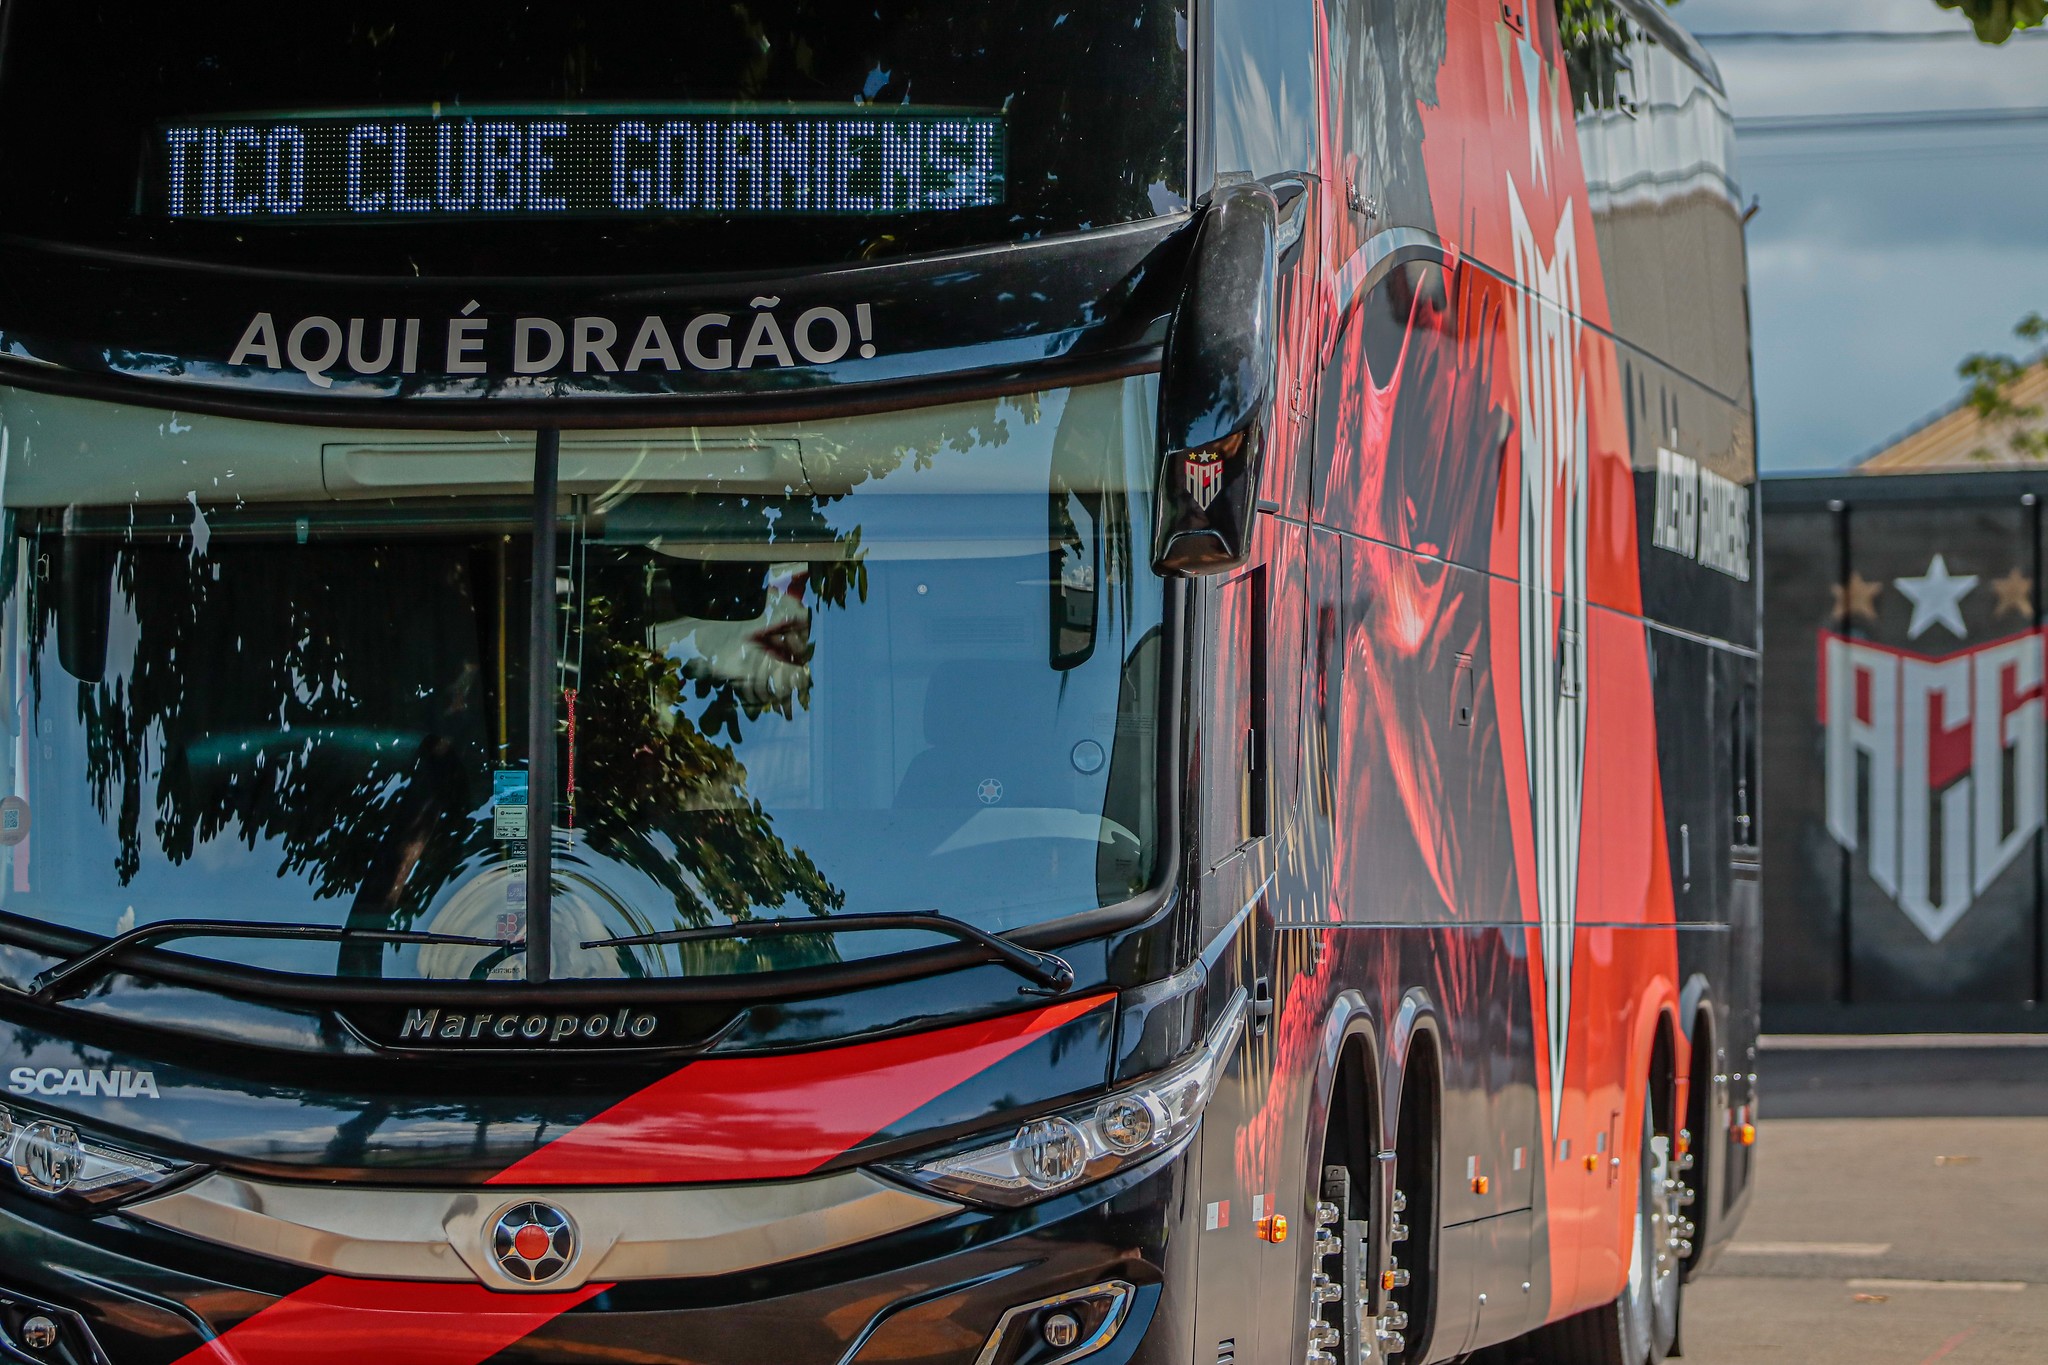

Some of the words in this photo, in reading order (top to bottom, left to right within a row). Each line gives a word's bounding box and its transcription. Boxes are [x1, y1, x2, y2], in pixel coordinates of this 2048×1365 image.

[166, 127, 304, 216] TICO
[348, 122, 568, 213] CLUBE
[228, 312, 420, 388] AQUI
[446, 299, 488, 373] É
[514, 296, 877, 373] DRAGÃO!
[400, 1008, 656, 1042] Marcopolo
[8, 1067, 160, 1099] SCANIA
